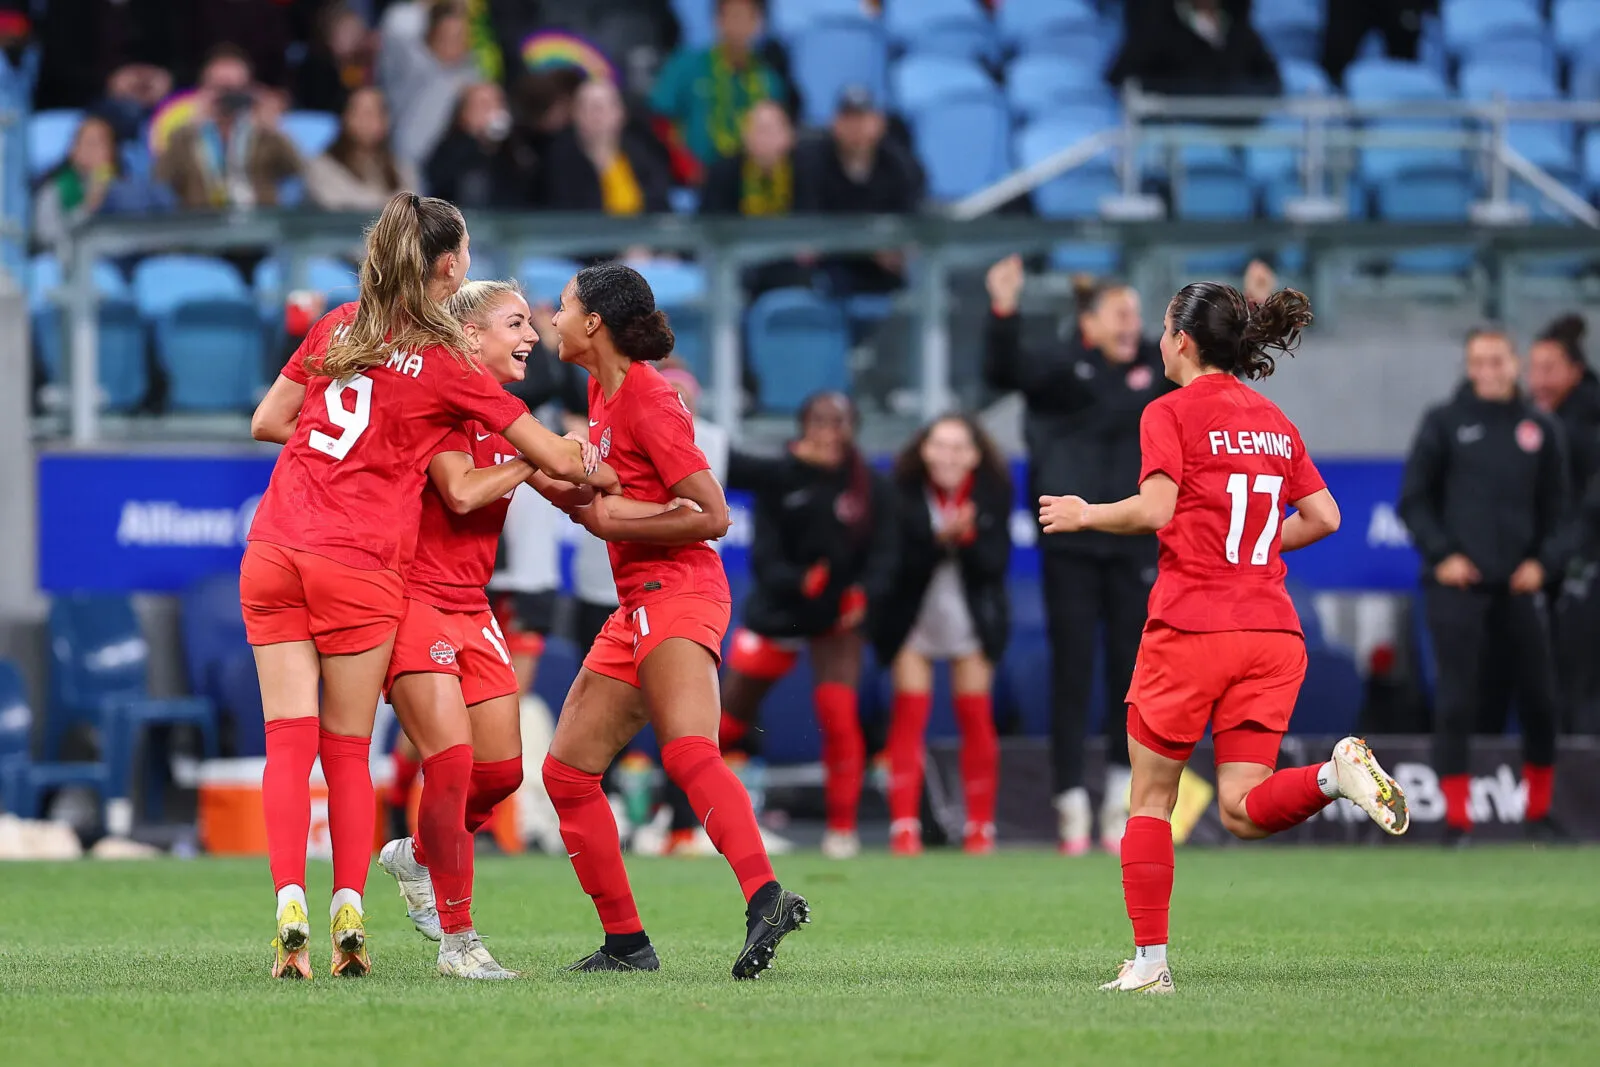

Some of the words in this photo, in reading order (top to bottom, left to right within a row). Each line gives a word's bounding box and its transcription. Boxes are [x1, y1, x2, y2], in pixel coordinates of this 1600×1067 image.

[308, 372, 374, 461] 9
[1208, 430, 1293, 460] FLEMING
[1225, 473, 1284, 566] 17
[1365, 763, 1388, 794] TIEMPO
[1393, 763, 1531, 823] Bnk
